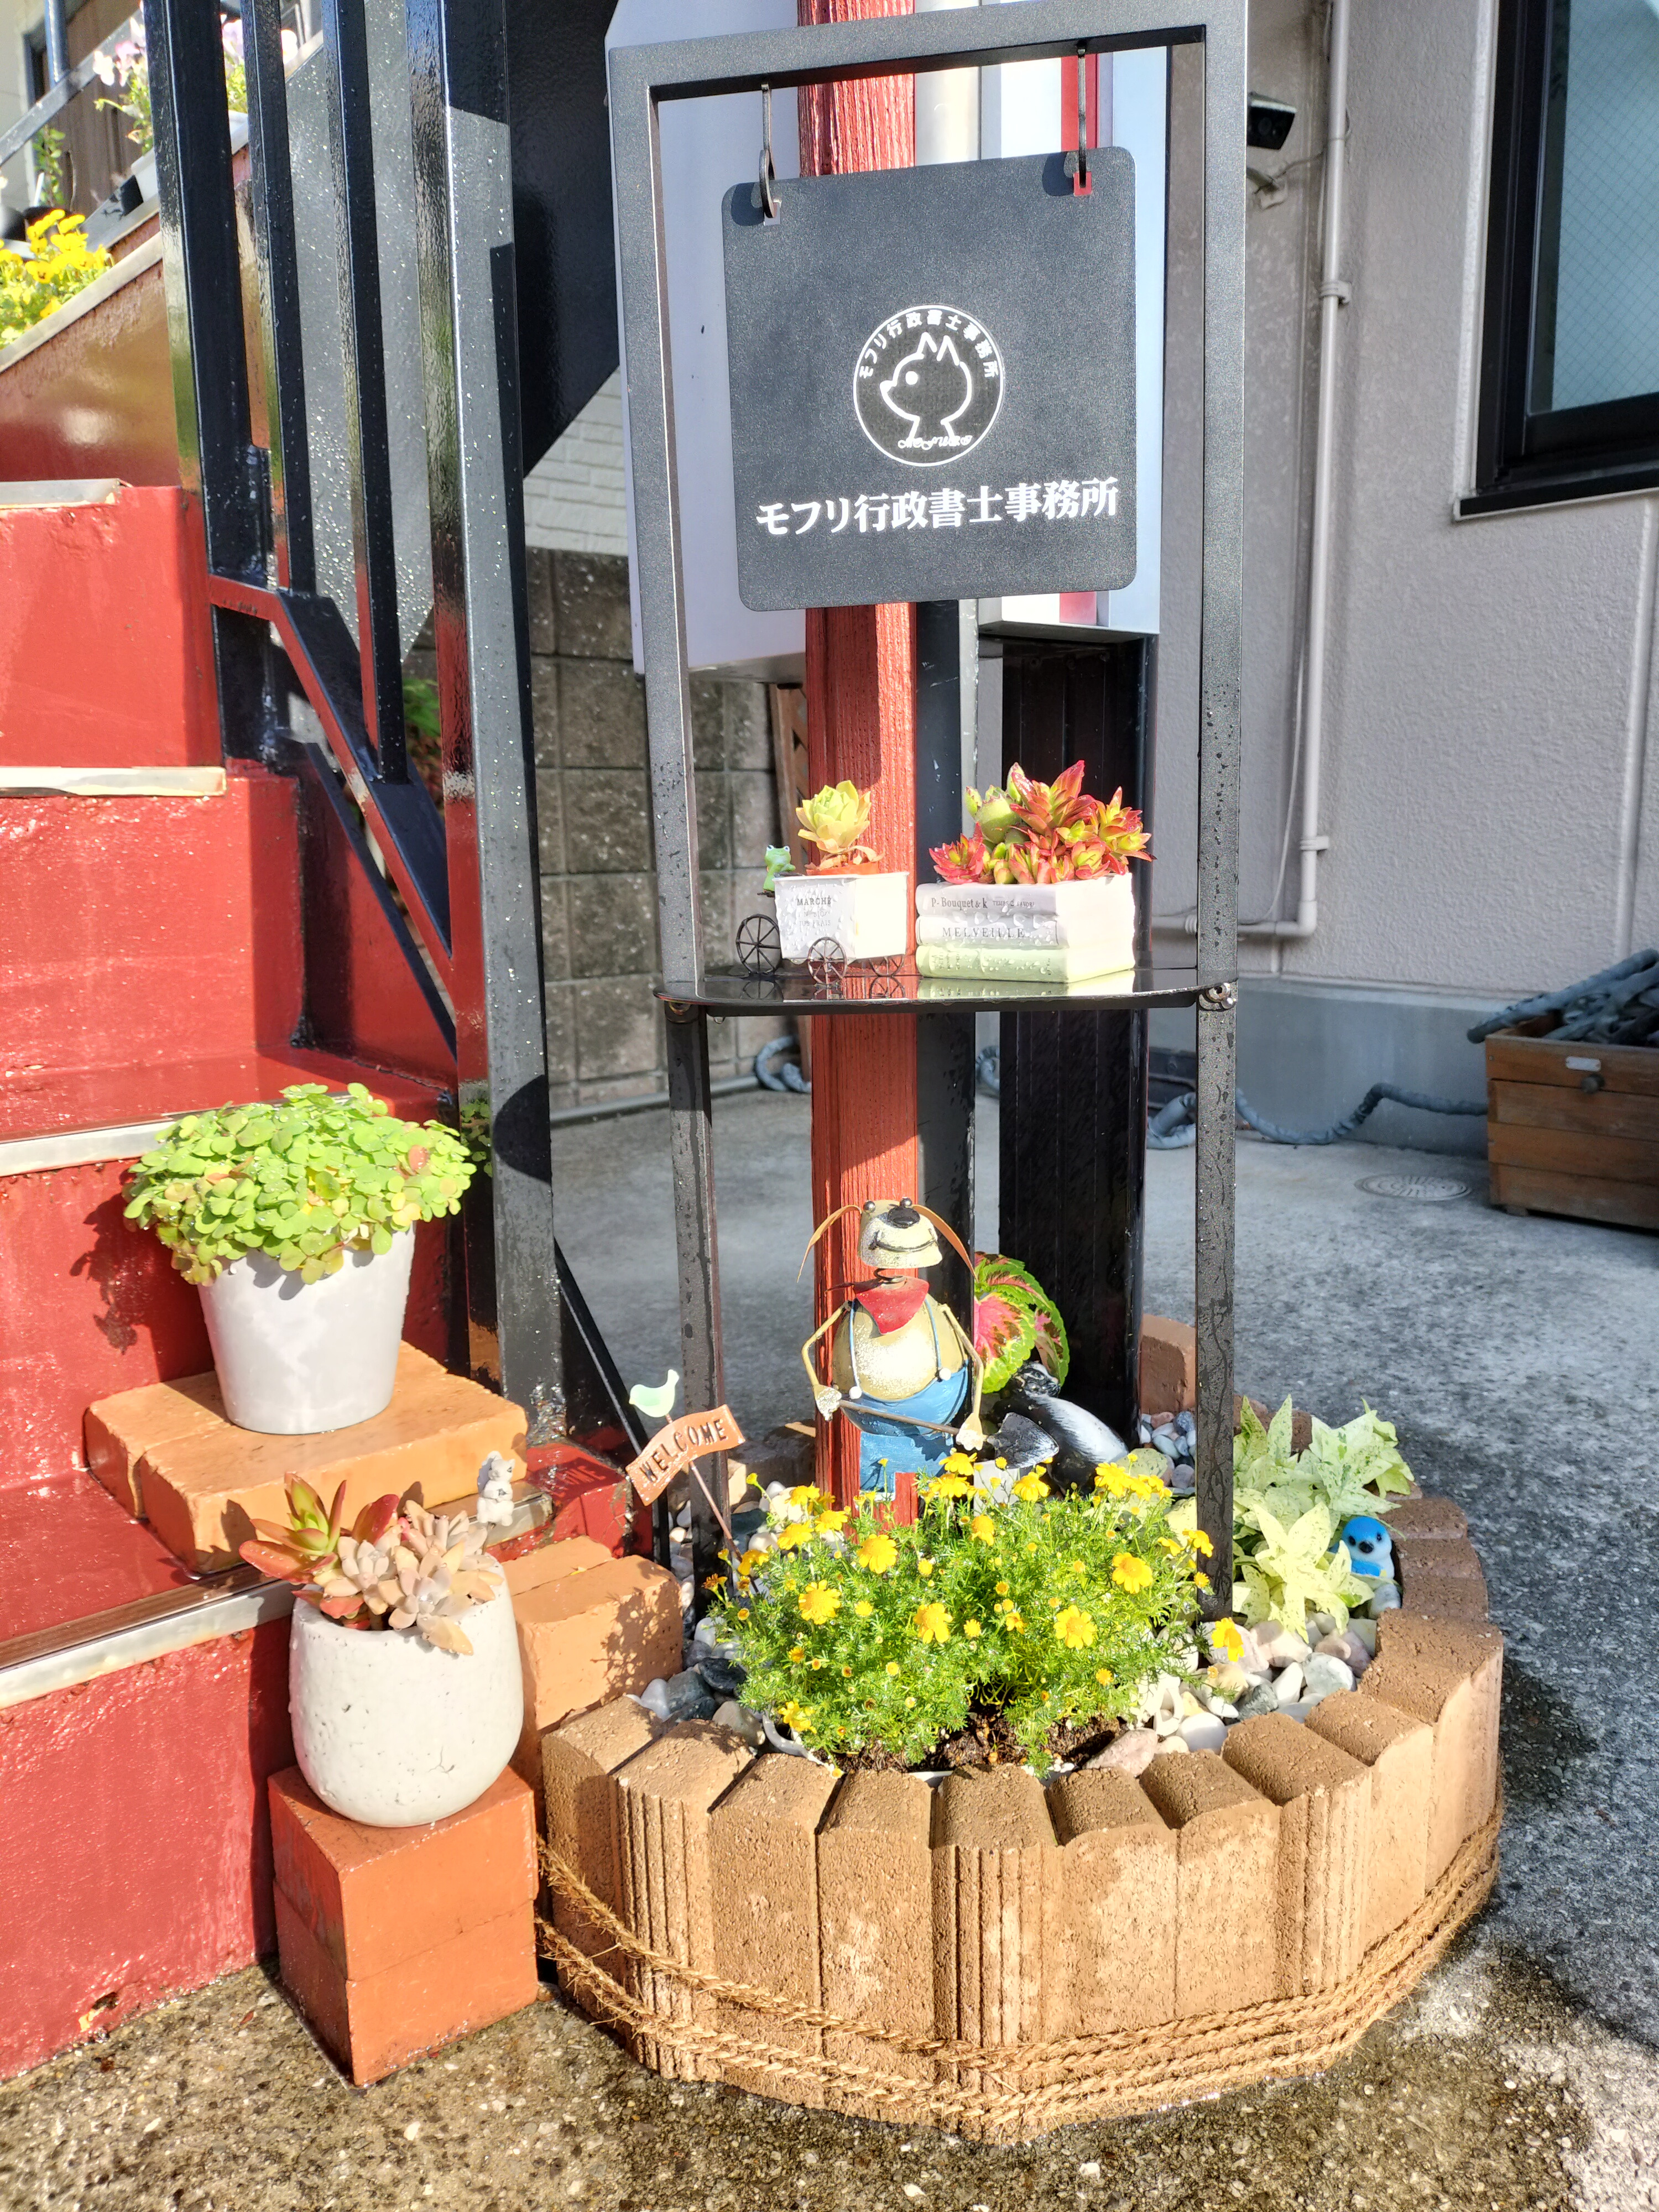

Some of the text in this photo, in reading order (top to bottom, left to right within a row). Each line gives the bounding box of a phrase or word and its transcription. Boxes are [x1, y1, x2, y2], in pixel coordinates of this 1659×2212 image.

[859, 309, 999, 379] モフリ行政書士事務所
[755, 475, 1119, 535] モフリ行政書士事務所
[941, 897, 974, 911] Bouquet
[639, 1418, 728, 1484] WELCOME
